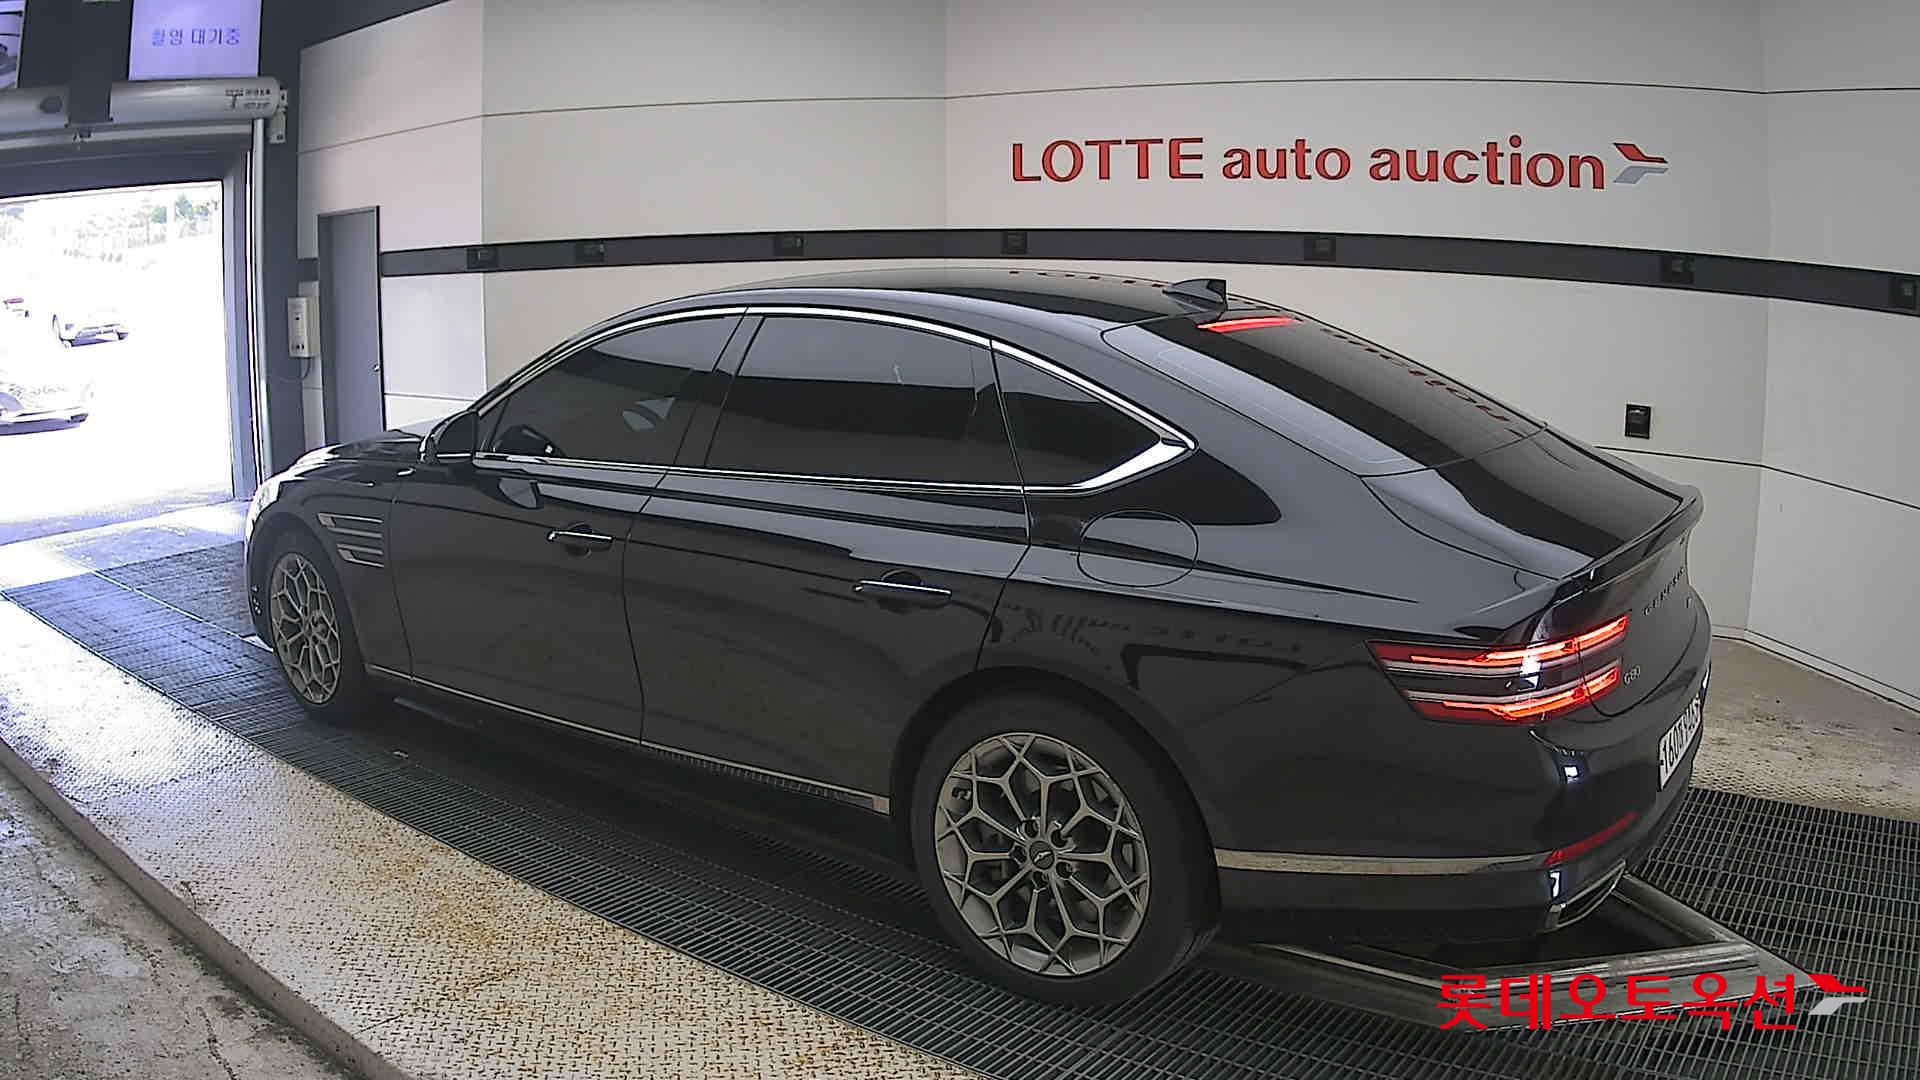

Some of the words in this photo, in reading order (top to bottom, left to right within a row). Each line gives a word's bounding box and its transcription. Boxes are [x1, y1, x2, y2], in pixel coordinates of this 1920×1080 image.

[191, 28, 240, 46] 대기중
[1012, 137, 1204, 182] LOTTE
[1222, 138, 1352, 181] auto
[1369, 134, 1605, 190] auction
